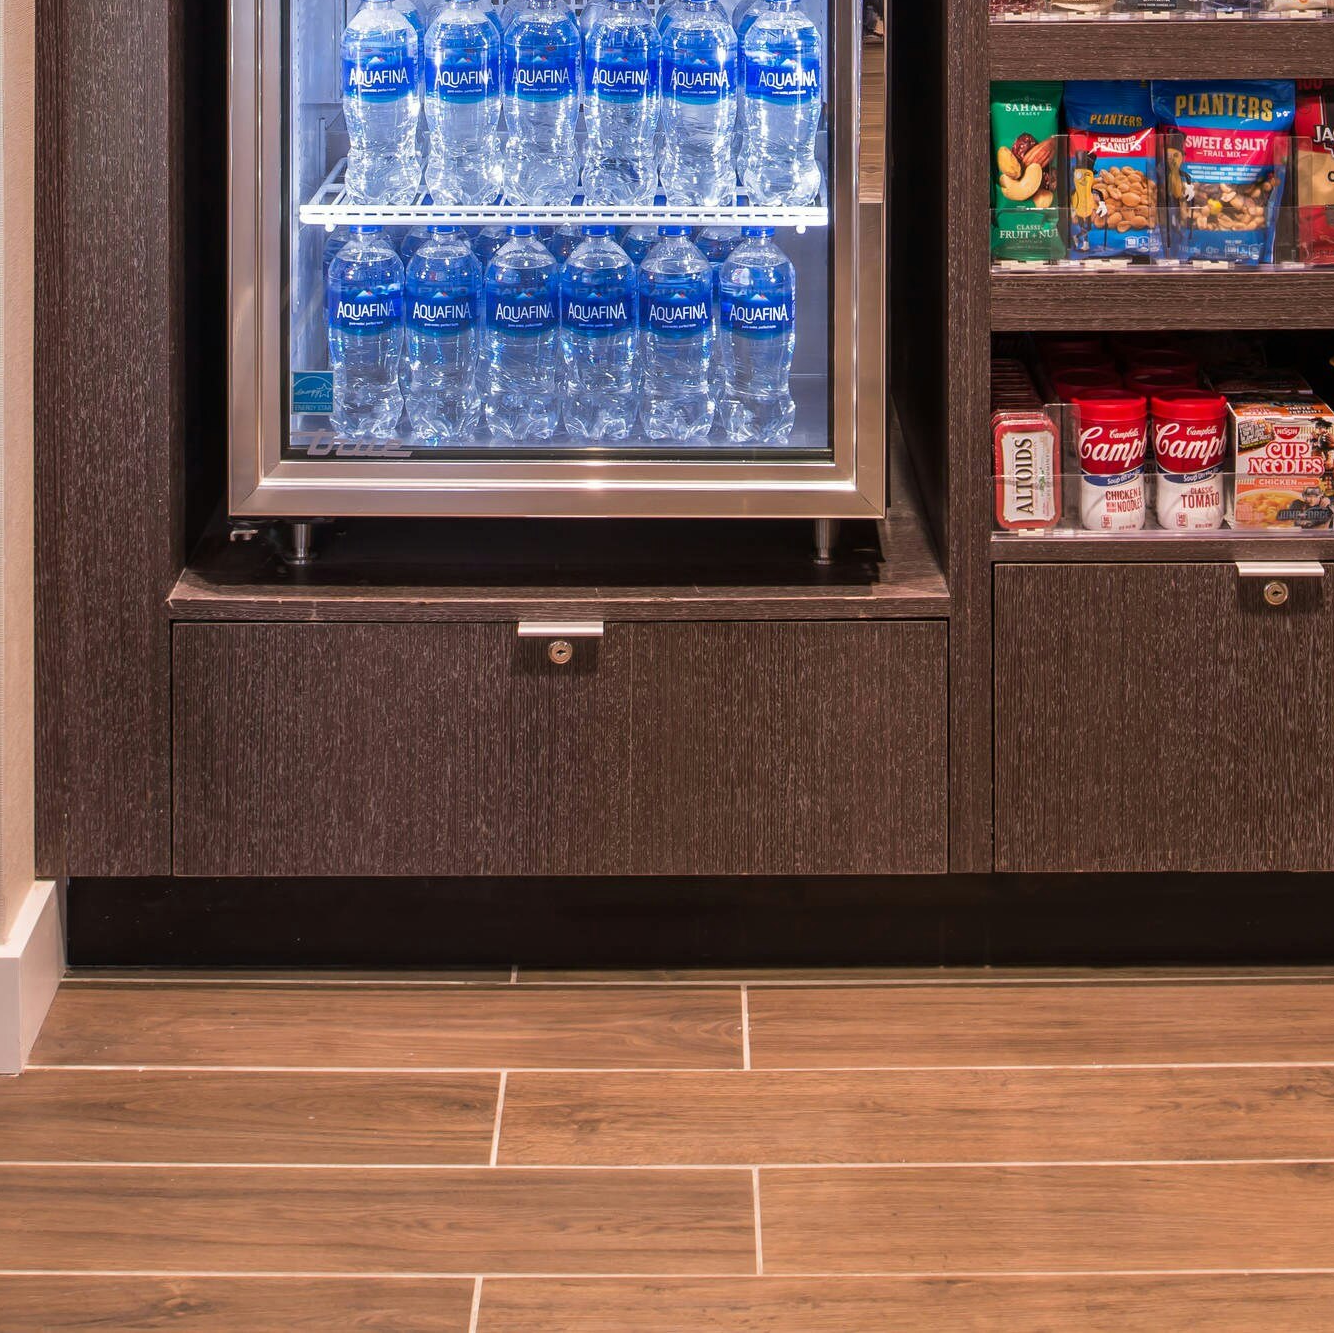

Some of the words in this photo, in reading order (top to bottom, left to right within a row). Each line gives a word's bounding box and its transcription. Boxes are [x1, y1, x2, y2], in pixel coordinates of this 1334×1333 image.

[349, 67, 410, 87] AQUAFINA
[435, 68, 494, 87] AQUAFINA
[513, 67, 570, 87] AQUAFINA
[591, 67, 651, 87] AQUAFINA
[670, 67, 730, 88] AQUAFINA
[758, 68, 817, 89] AQUAFINA
[1005, 103, 1052, 112] SAHALE
[1175, 93, 1273, 122] PLANTERS
[1089, 113, 1143, 127] PLANTERS
[1093, 141, 1142, 153] PEANUTS
[1185, 136, 1223, 150] SWEET
[1224, 137, 1233, 150] &
[1234, 138, 1269, 152] SALTY
[336, 300, 395, 321] AQUAFINA
[413, 301, 473, 321] AQUAFINA
[495, 302, 555, 322] AQUAFINA
[568, 302, 627, 322] AQUAFINA
[649, 302, 708, 323] AQUAFINA
[729, 302, 789, 323] AQUAFINA
[1266, 441, 1309, 459] CUP
[1015, 436, 1034, 515] ALTOIDS
[1248, 457, 1324, 476] NOODLES
[1107, 475, 1122, 485] Soup
[1183, 474, 1197, 484] Soup
[1105, 490, 1136, 501] CHICKEN
[1190, 487, 1213, 495] CLASSIC
[1117, 499, 1143, 513] NOODLES
[1181, 493, 1220, 509] TOMATO
